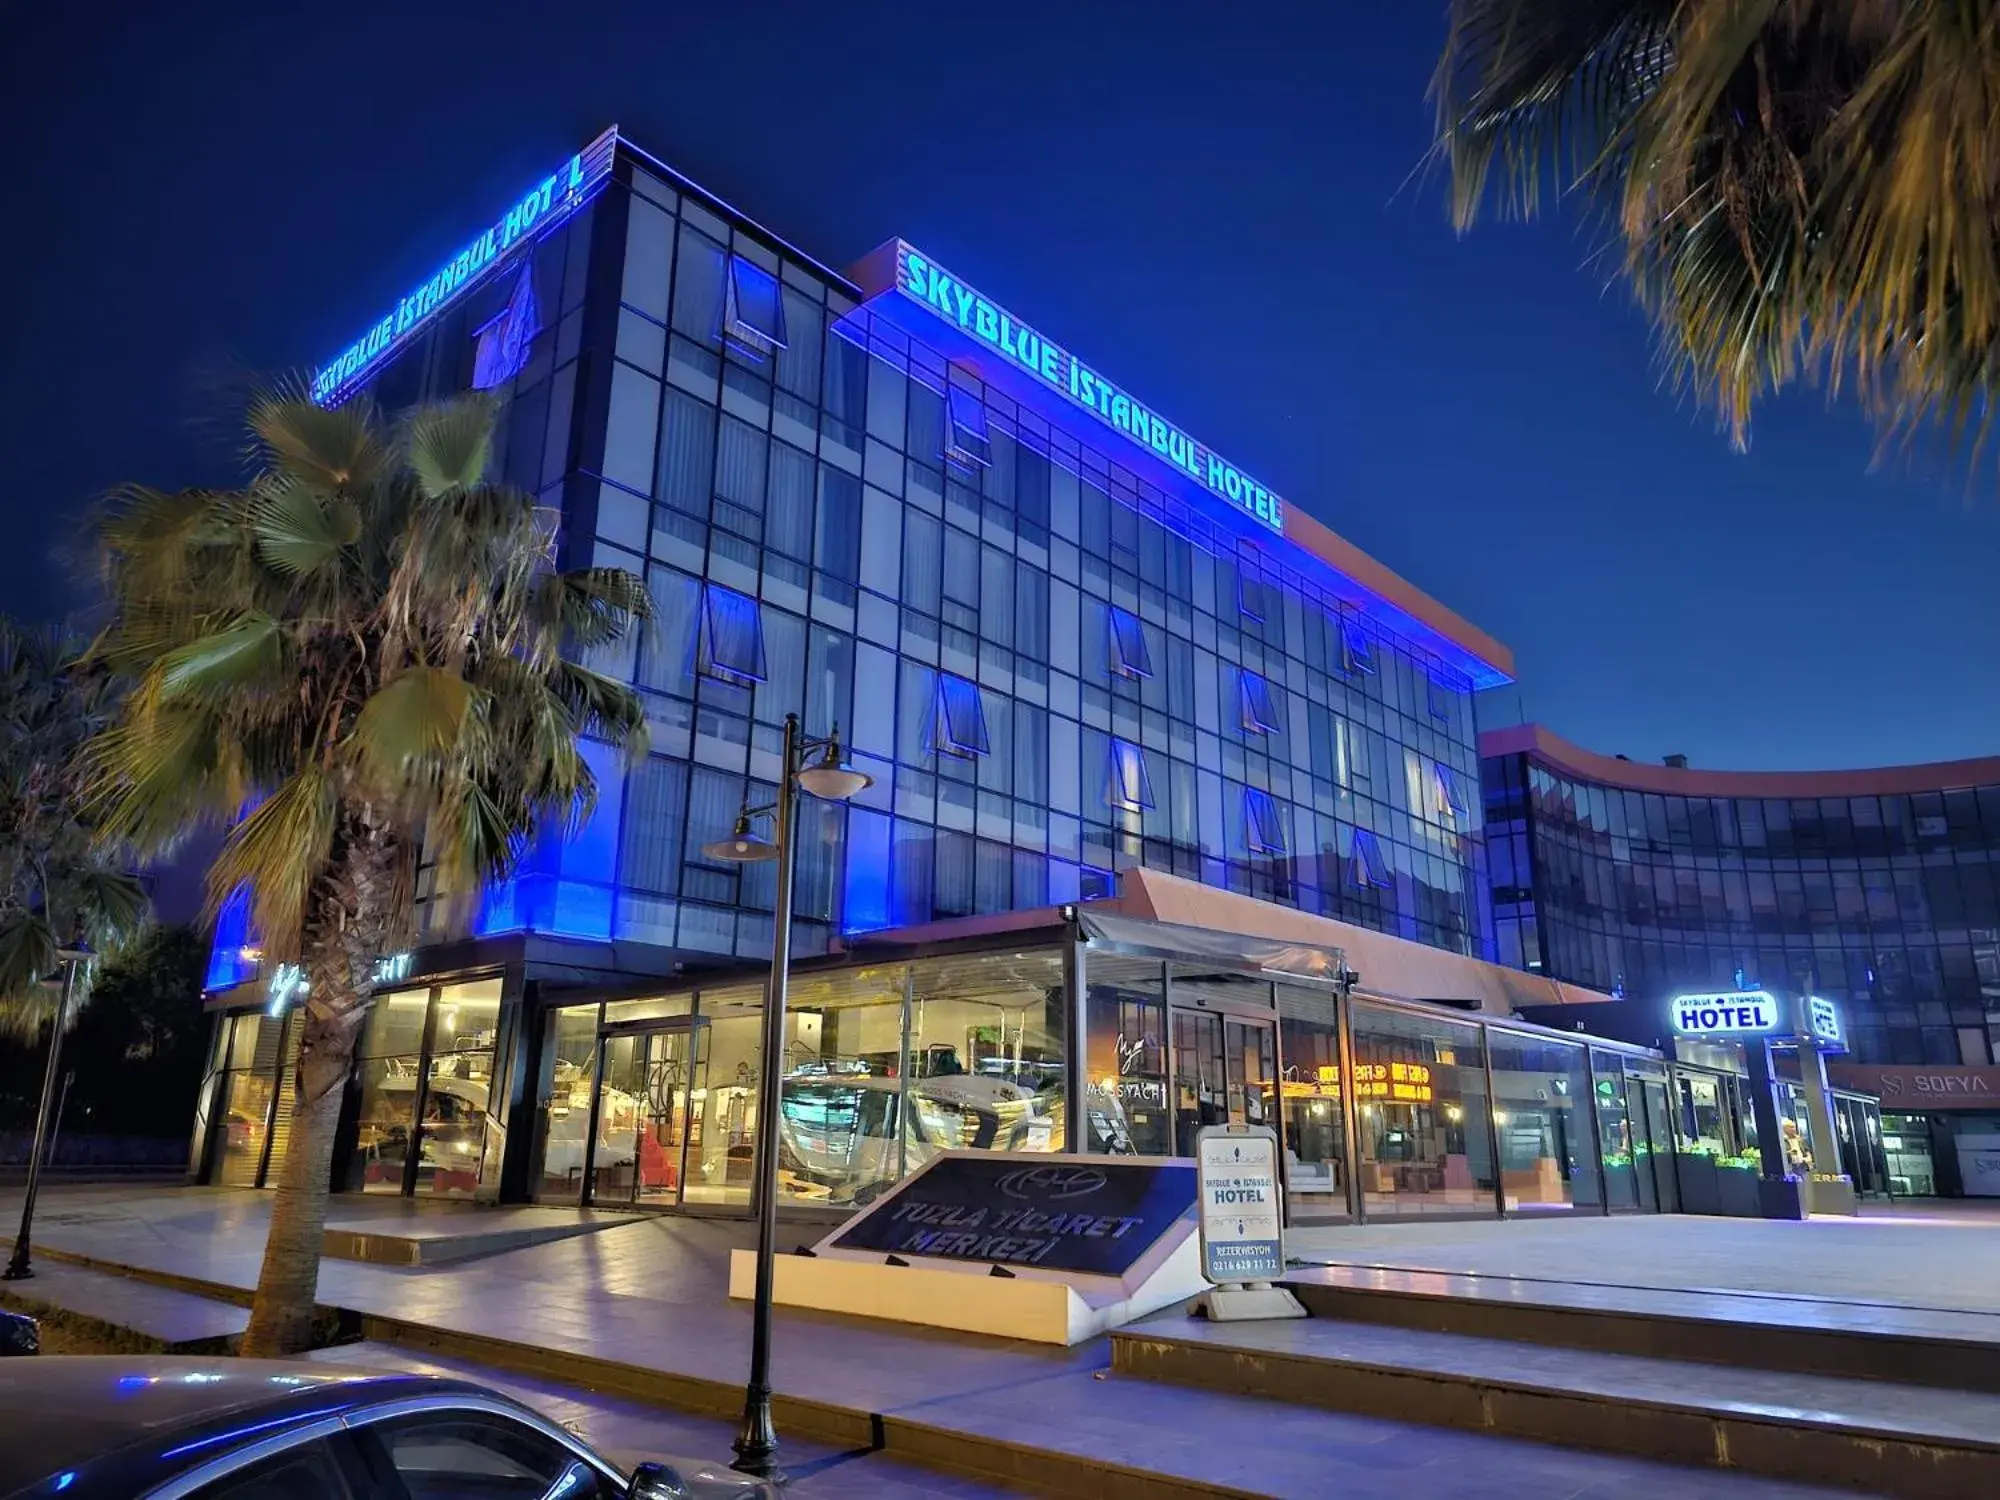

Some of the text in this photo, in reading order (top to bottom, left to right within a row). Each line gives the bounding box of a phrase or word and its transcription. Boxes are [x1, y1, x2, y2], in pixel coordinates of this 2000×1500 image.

[906, 253, 1060, 385] SKYBLUE
[1207, 453, 1282, 529] HOTEL
[1680, 1006, 1769, 1030] HOTEL
[1214, 1189, 1265, 1204] HOTEL
[892, 1202, 988, 1228] TUZLA
